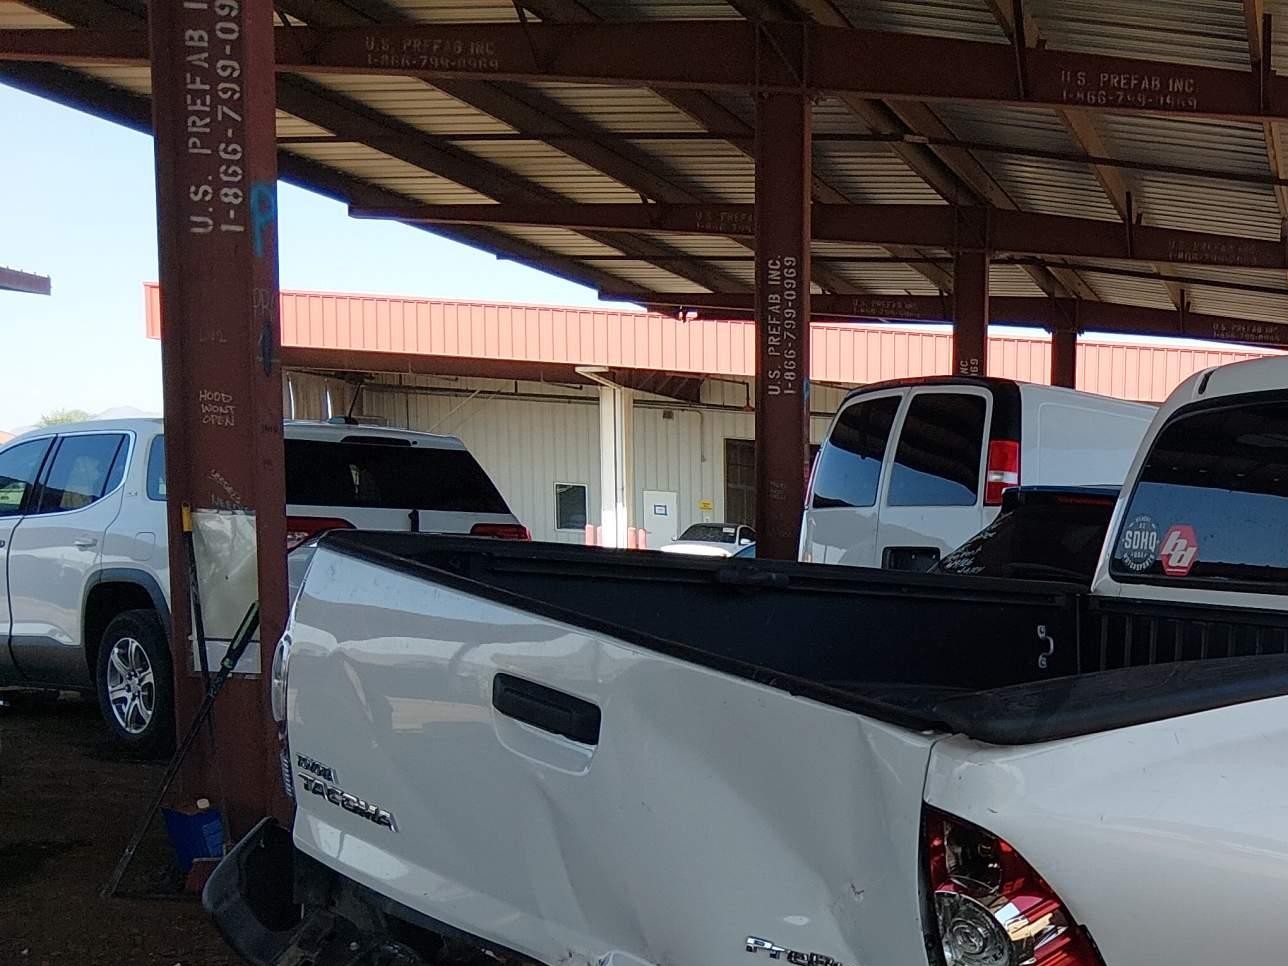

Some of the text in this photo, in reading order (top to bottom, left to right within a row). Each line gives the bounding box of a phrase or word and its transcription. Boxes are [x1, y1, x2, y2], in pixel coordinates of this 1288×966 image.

[183, 28, 211, 154] PREFAB
[1099, 72, 1161, 91] PREFAB
[189, 175, 213, 234] U.S.
[767, 293, 781, 356] PREFAB
[783, 256, 797, 394] 1-866-799-0969
[767, 366, 781, 395] U.S.
[202, 414, 236, 426] OPEN
[1124, 530, 1157, 553] SDHQ
